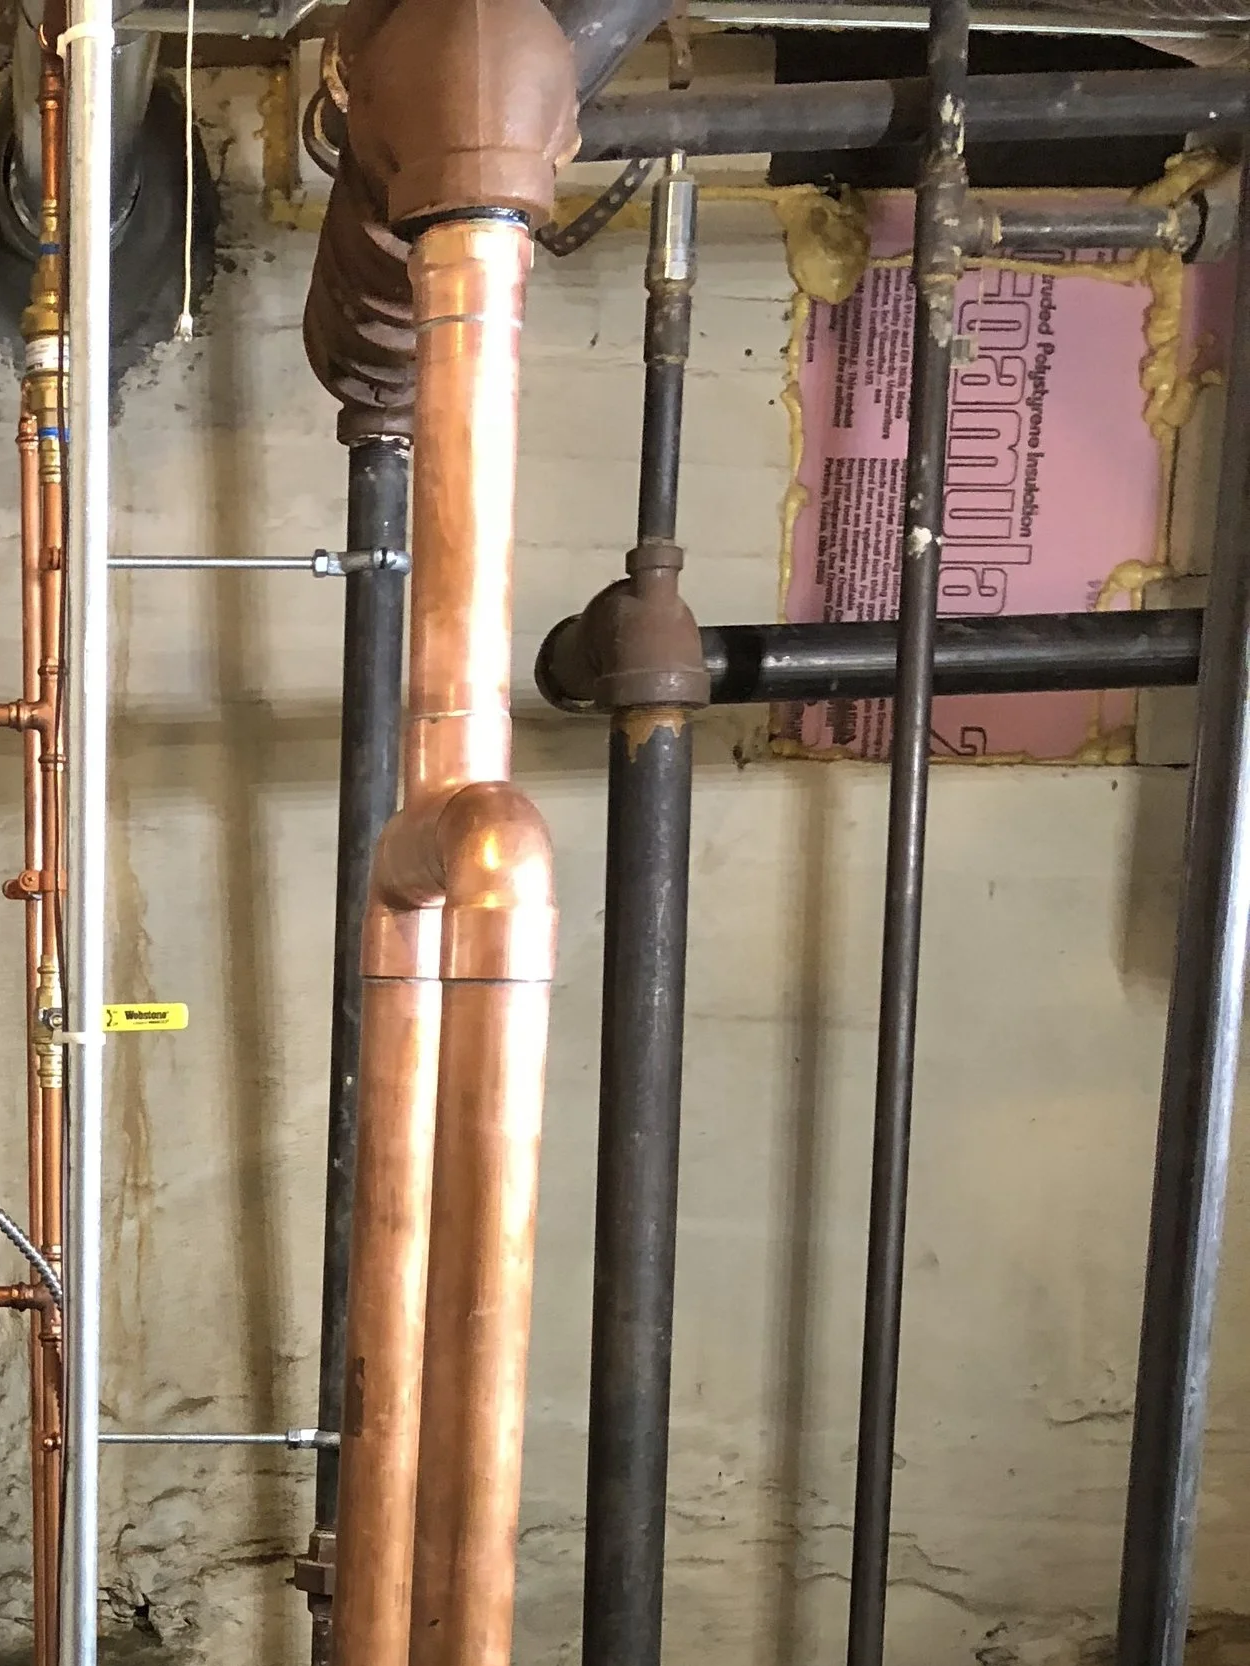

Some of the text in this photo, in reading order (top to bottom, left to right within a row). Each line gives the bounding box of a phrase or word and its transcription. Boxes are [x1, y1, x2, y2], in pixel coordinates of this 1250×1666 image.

[1019, 272, 1057, 537] truded Polystyrene Insulation
[938, 262, 1036, 615] Foamula
[868, 458, 878, 485] board
[883, 530, 893, 560] Owens
[880, 562, 891, 597] Corning
